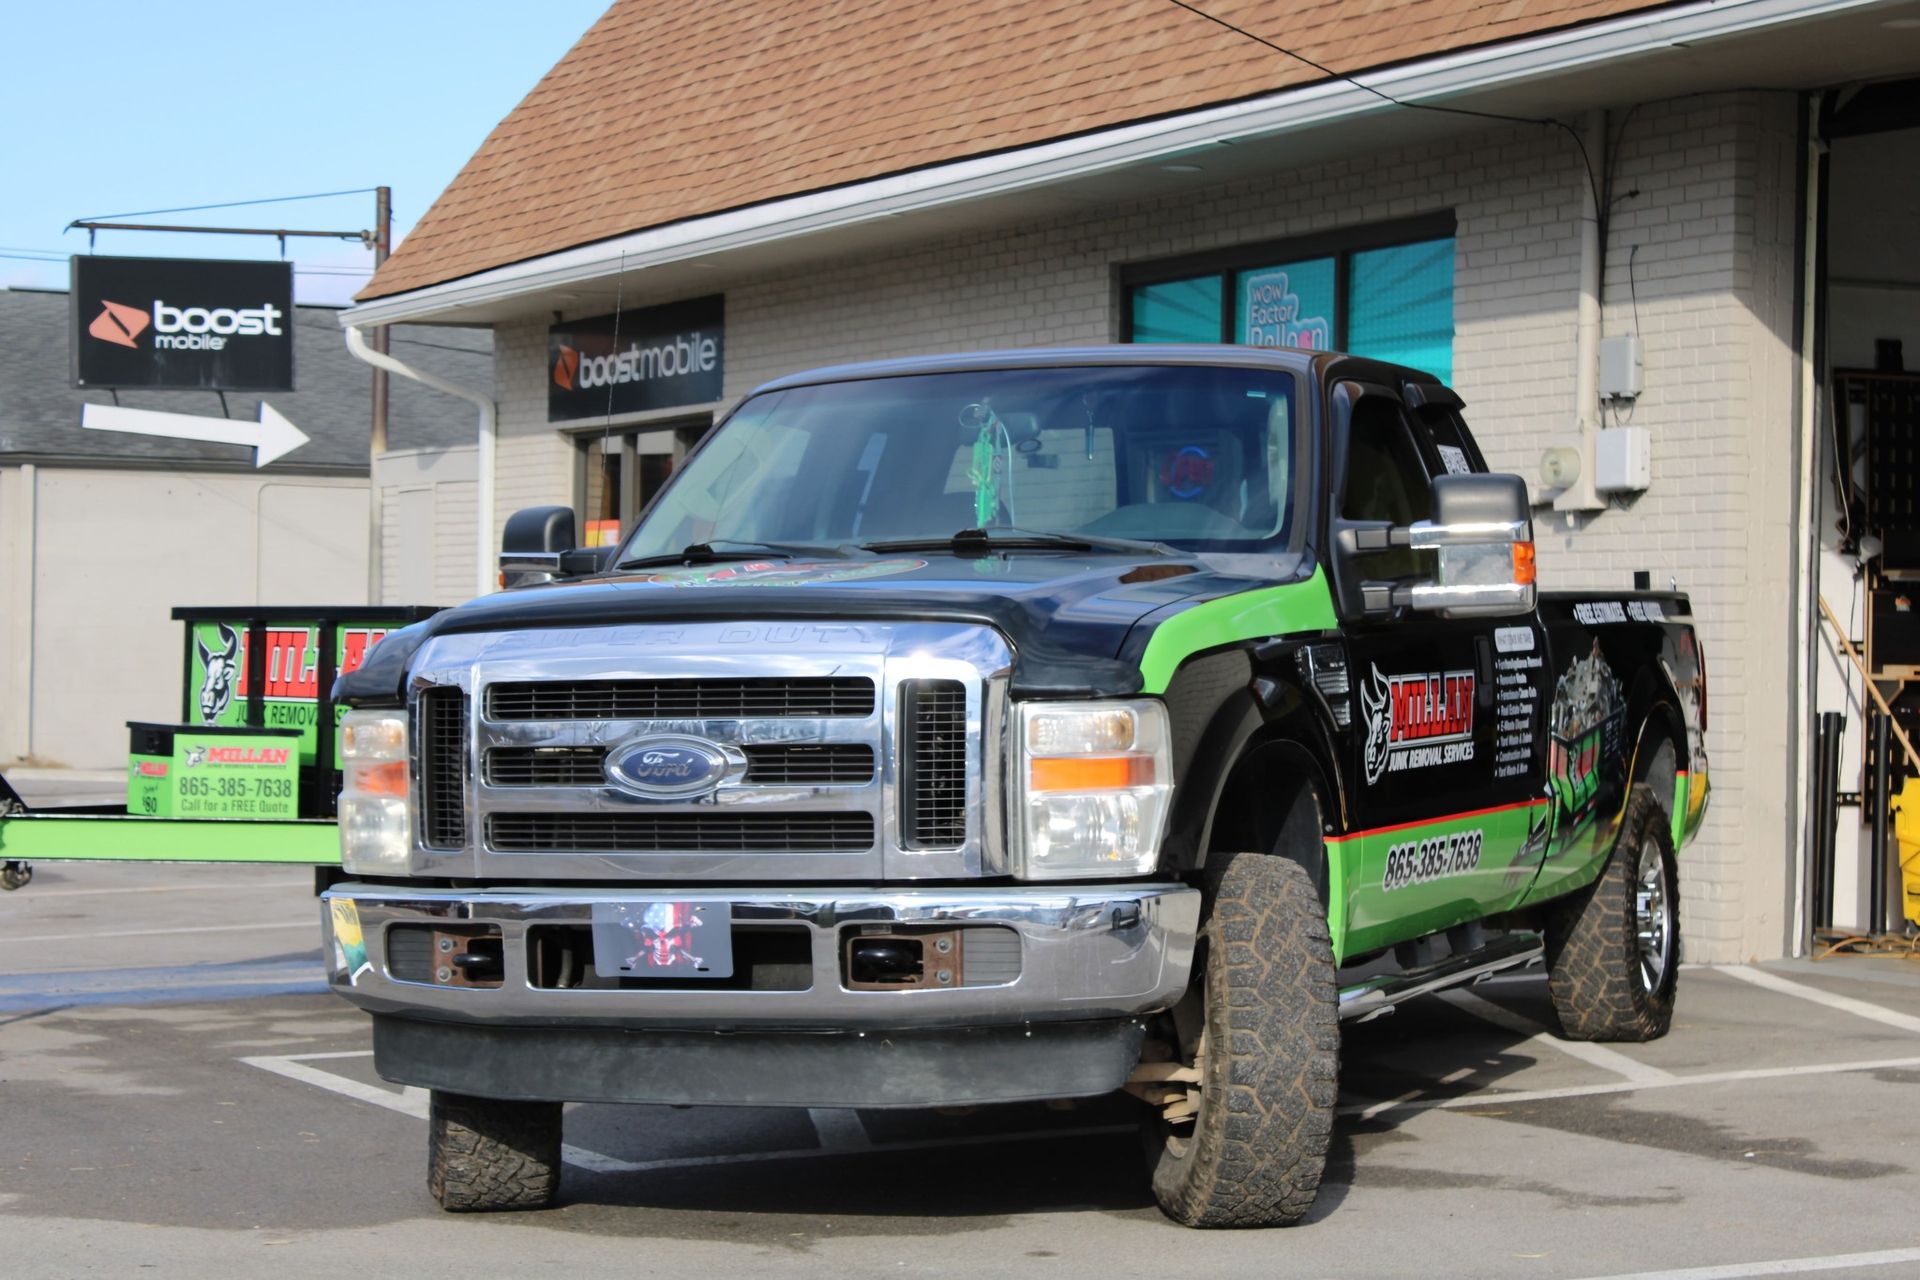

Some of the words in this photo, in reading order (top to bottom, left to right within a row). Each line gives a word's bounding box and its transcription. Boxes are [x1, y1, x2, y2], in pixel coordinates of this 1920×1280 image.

[1252, 284, 1281, 304] WOW
[154, 299, 282, 336] boost
[1250, 303, 1293, 325] Factor
[154, 333, 225, 351] mobile
[717, 625, 893, 645] DUTY
[1388, 671, 1475, 748] MILLAN
[637, 751, 694, 777] Ford
[1388, 750, 1409, 772] JUNK
[1408, 746, 1443, 769] REMOVAL
[1443, 741, 1475, 764] SERVICES
[179, 776, 292, 798] 865-385-7638
[181, 799, 200, 812] Call
[204, 799, 219, 812] for
[221, 803, 228, 812] a
[231, 800, 256, 813] FREE
[259, 800, 289, 814] Quote
[1383, 830, 1483, 891] 865-385-7638
